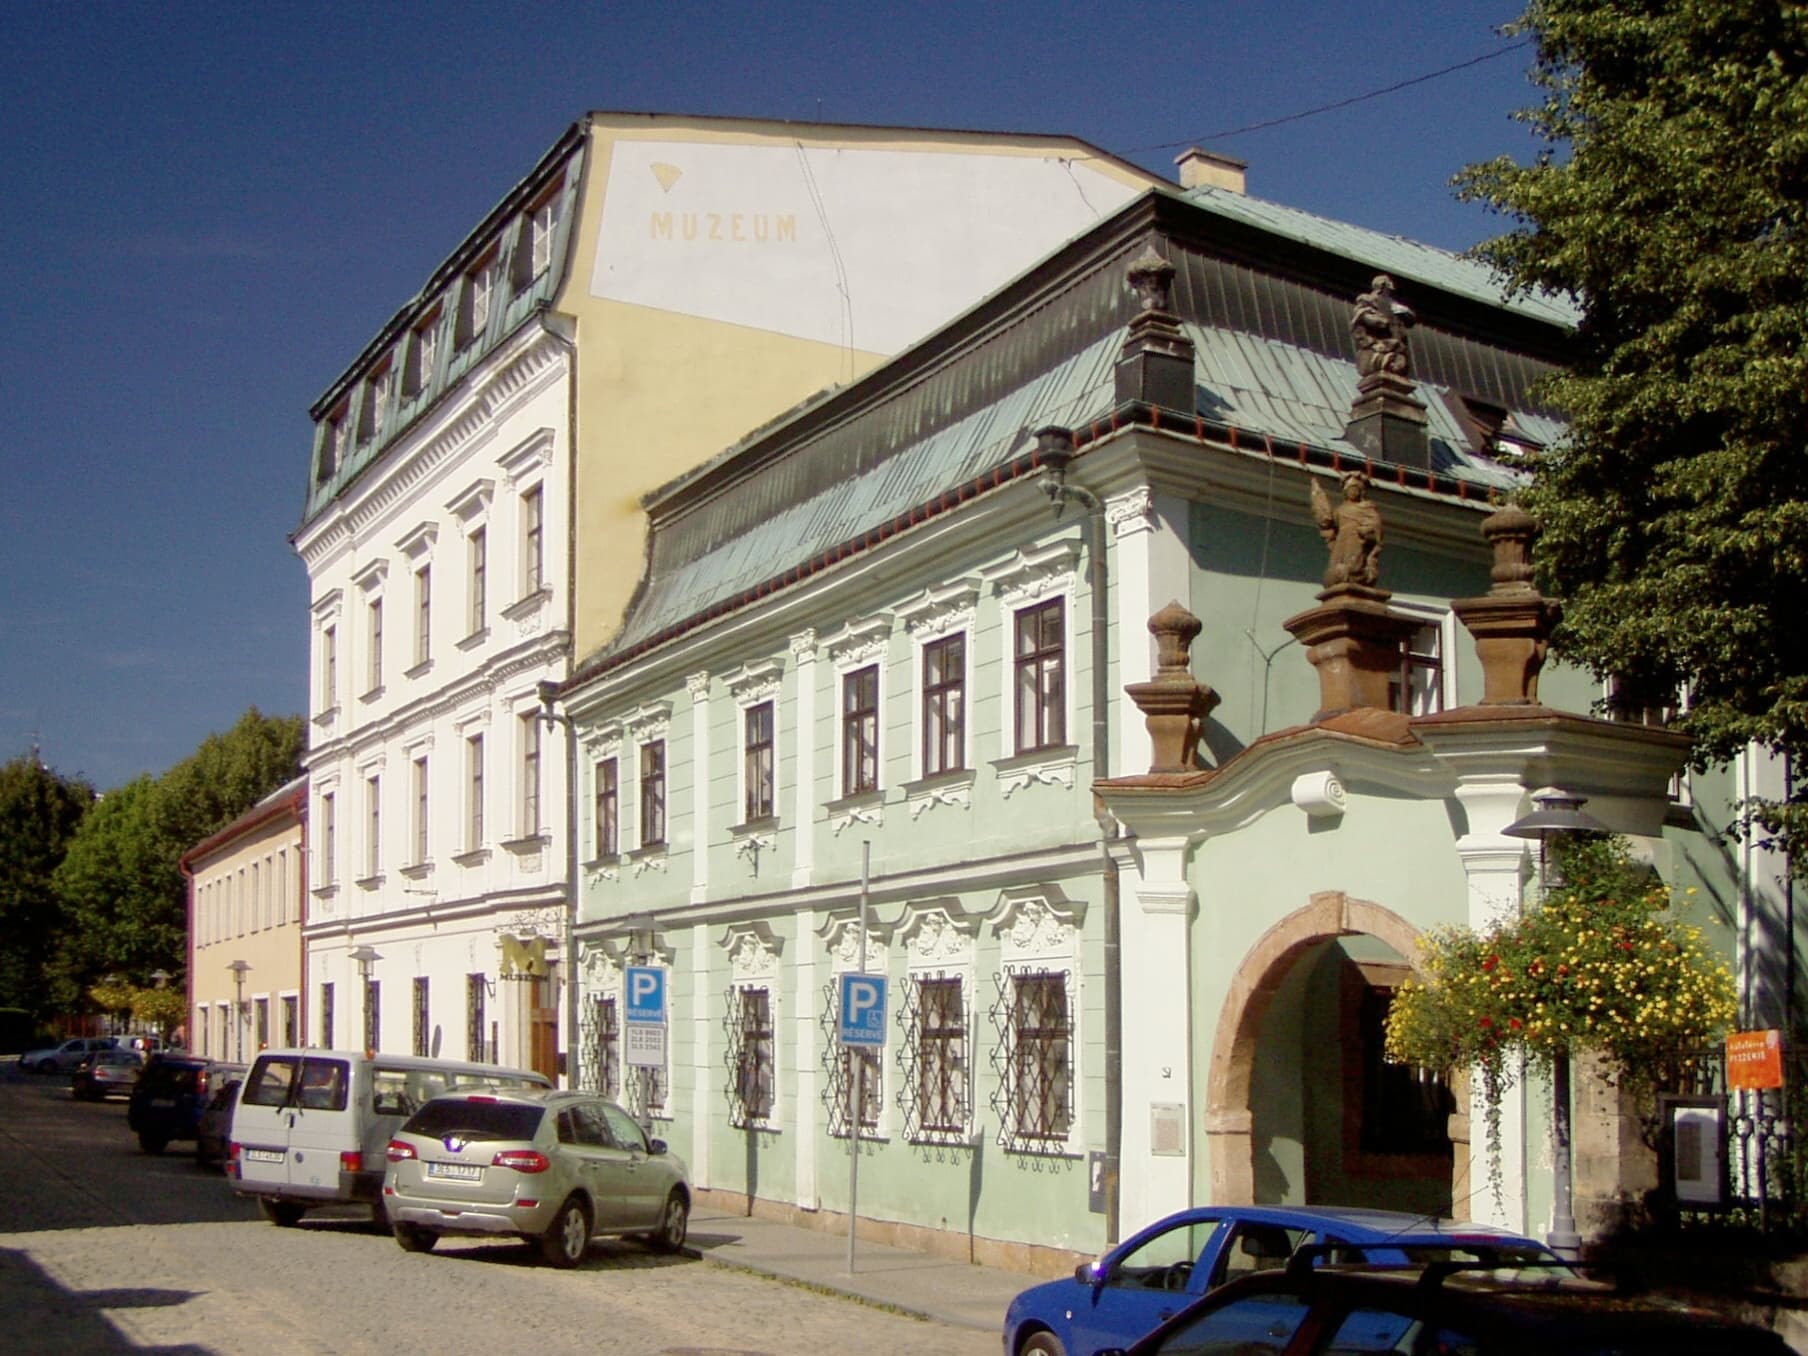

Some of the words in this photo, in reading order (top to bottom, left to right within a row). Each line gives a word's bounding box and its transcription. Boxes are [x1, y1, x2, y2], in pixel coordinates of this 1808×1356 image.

[650, 211, 797, 242] MUZEUM
[499, 933, 548, 974] M
[632, 973, 657, 1006] P
[849, 982, 877, 1024] P
